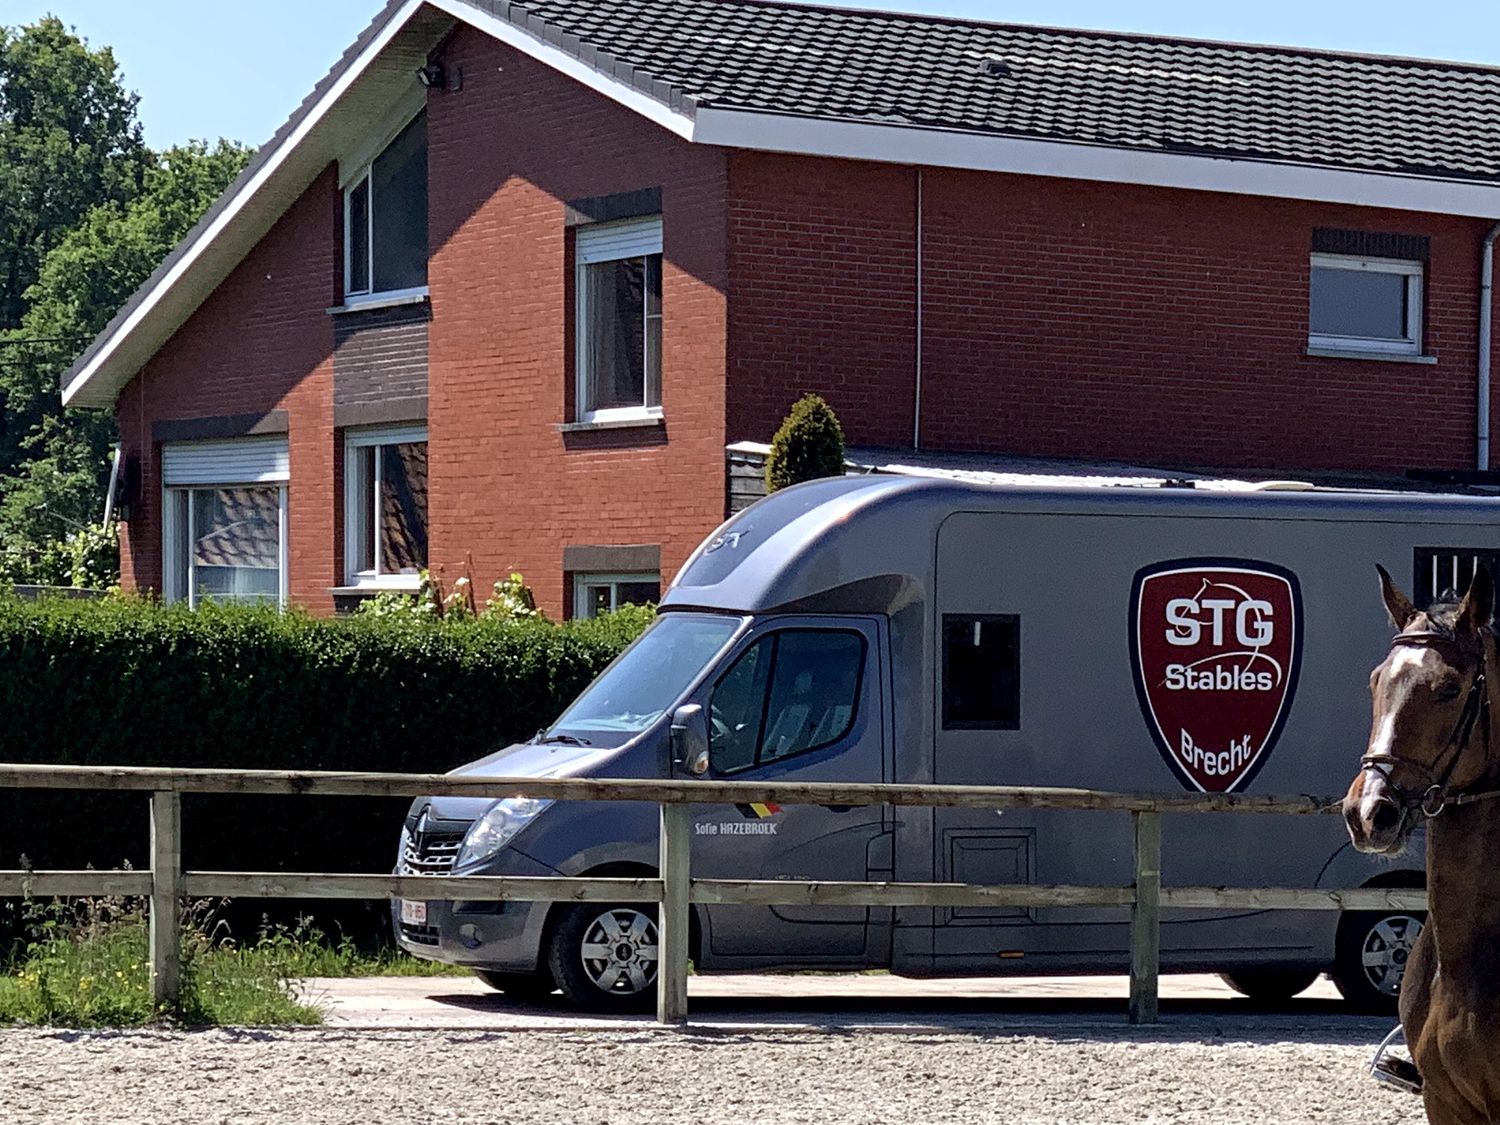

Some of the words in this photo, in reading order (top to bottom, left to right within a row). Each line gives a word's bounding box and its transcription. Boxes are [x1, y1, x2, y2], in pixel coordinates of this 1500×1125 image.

[1165, 598, 1274, 646] STG
[1165, 664, 1272, 690] Stables
[1181, 728, 1251, 776] Brecht
[694, 823, 717, 835] Sofie
